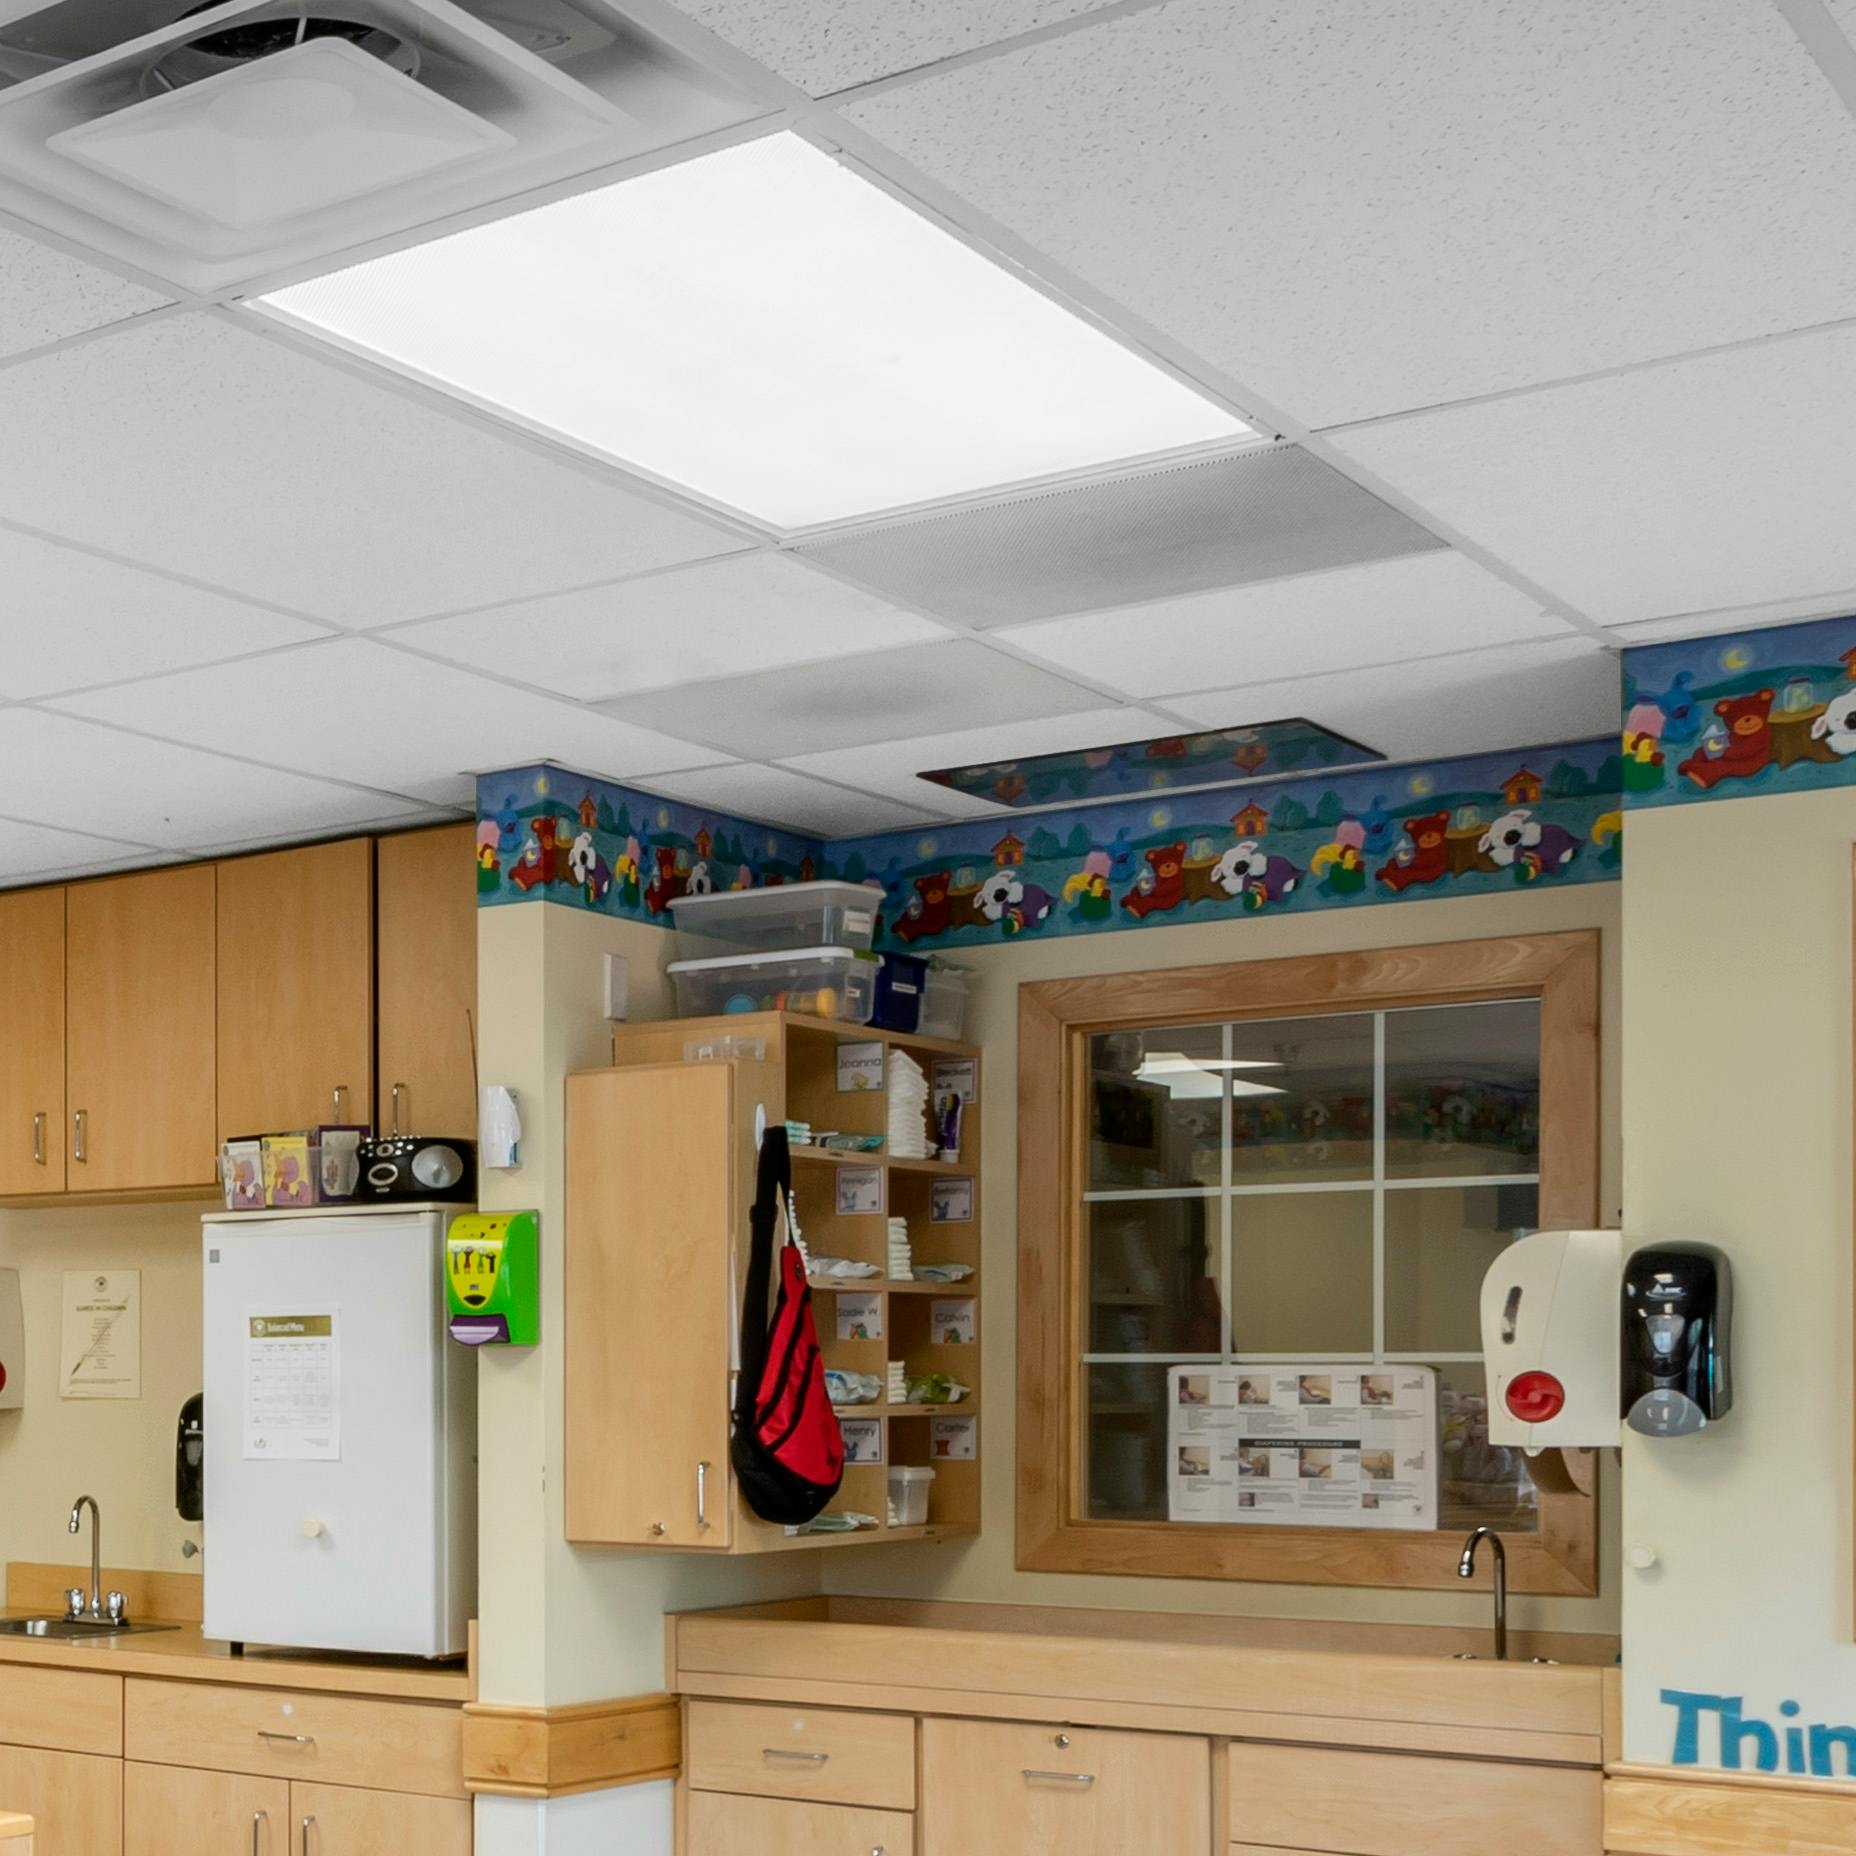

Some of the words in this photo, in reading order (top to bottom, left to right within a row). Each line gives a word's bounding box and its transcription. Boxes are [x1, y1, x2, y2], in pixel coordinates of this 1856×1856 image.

[839, 1058, 882, 1070] Joanna
[844, 1424, 877, 1438] Henry
[1660, 1688, 1856, 1777] Thin
